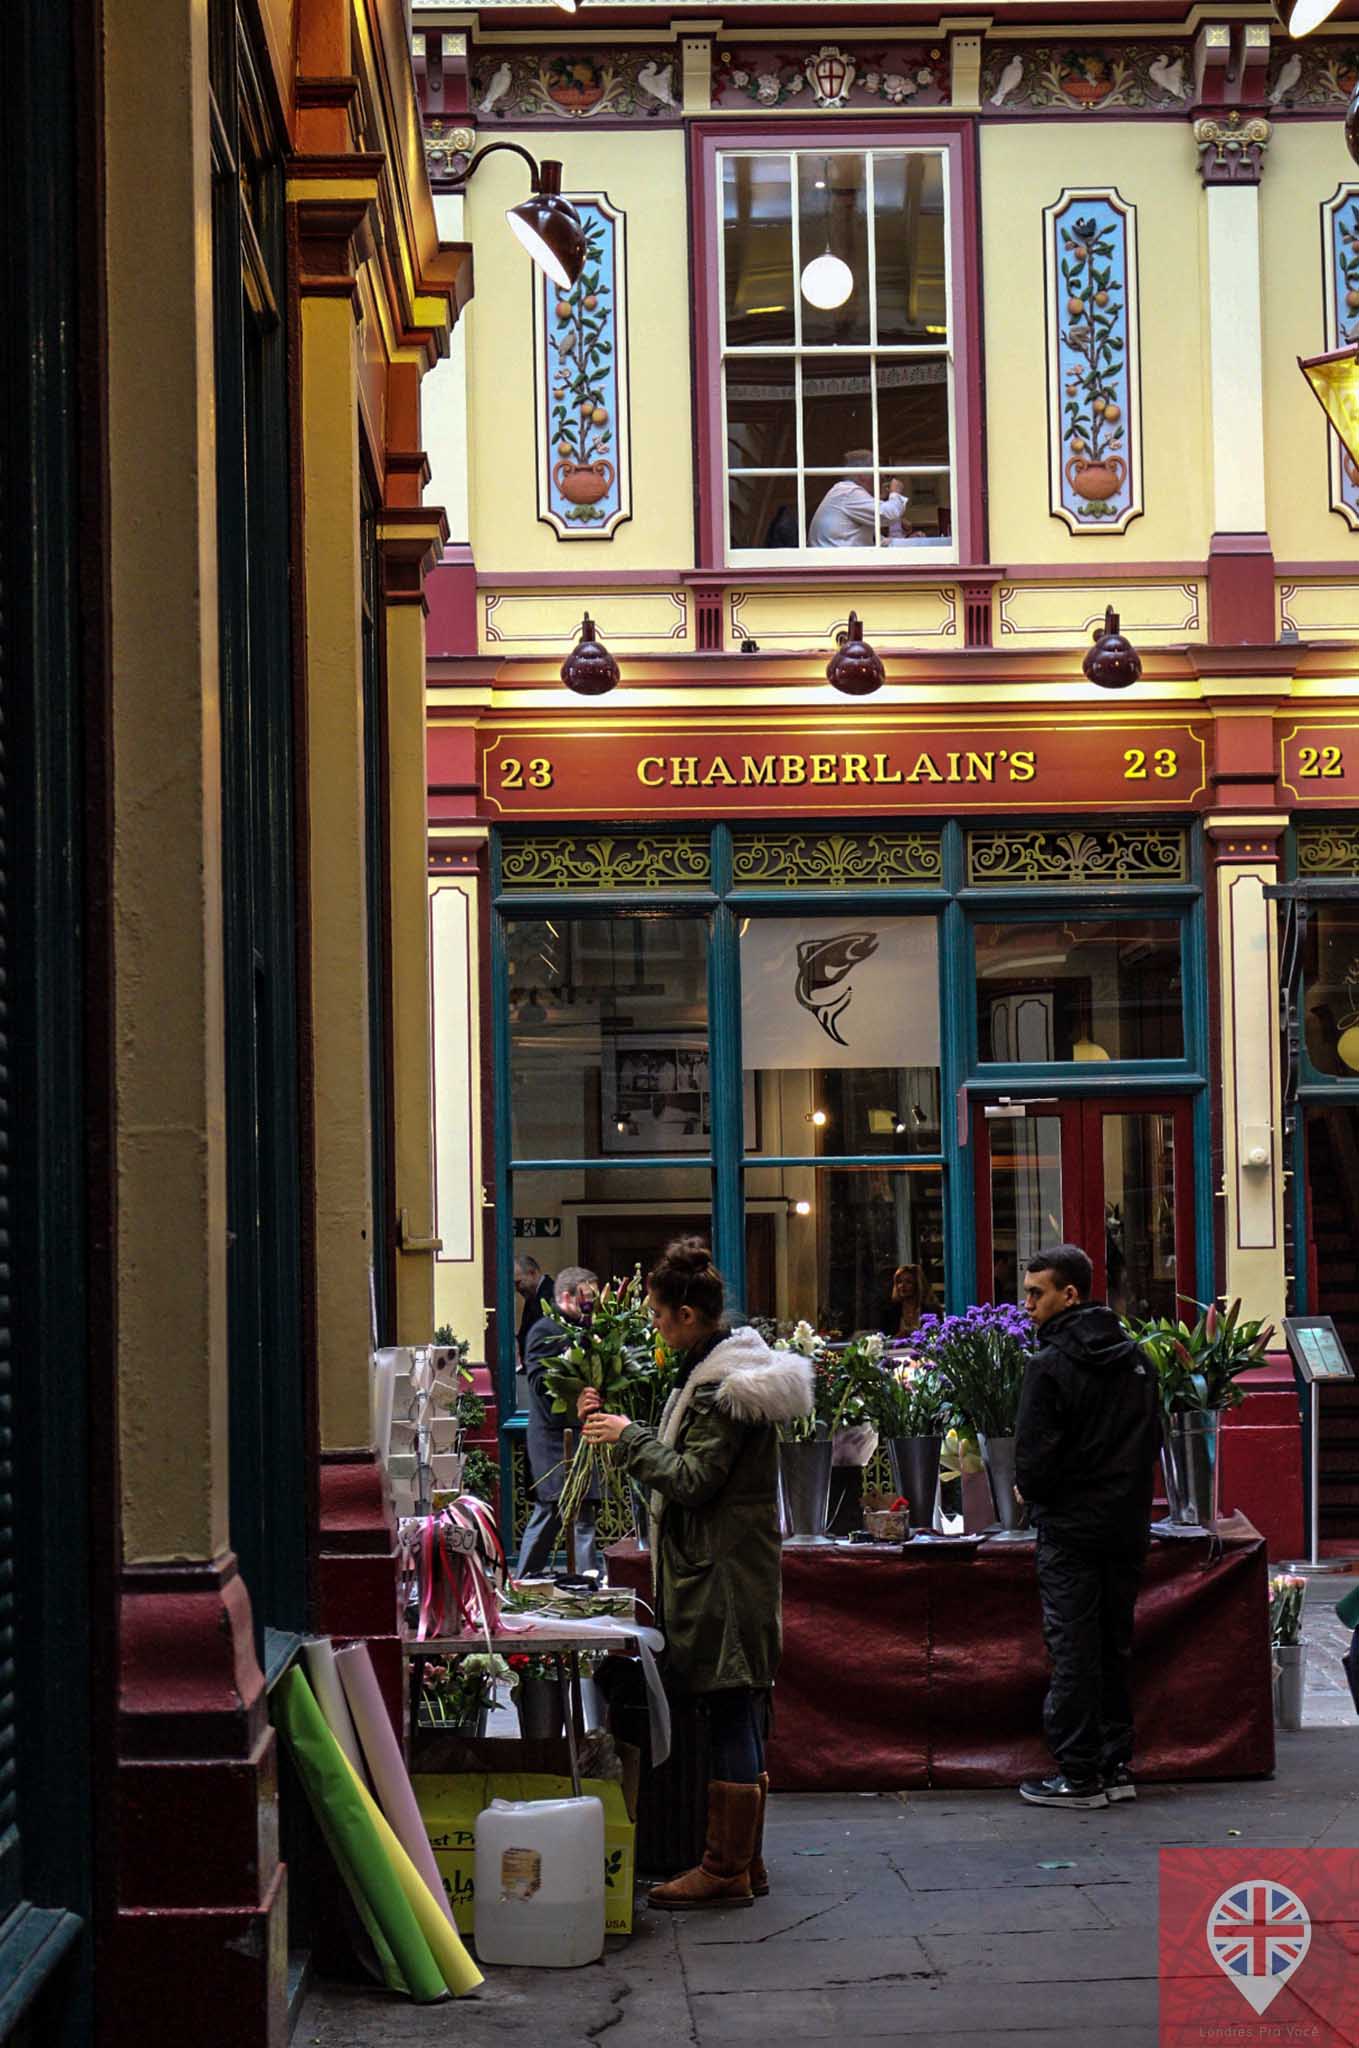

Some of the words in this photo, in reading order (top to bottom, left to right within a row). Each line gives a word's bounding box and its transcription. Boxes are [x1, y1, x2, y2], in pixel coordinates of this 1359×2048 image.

[500, 759, 554, 788] 23
[636, 751, 1036, 786] CHAMBERLAIN'S
[1123, 748, 1178, 779] 23
[1298, 746, 1343, 777] 22
